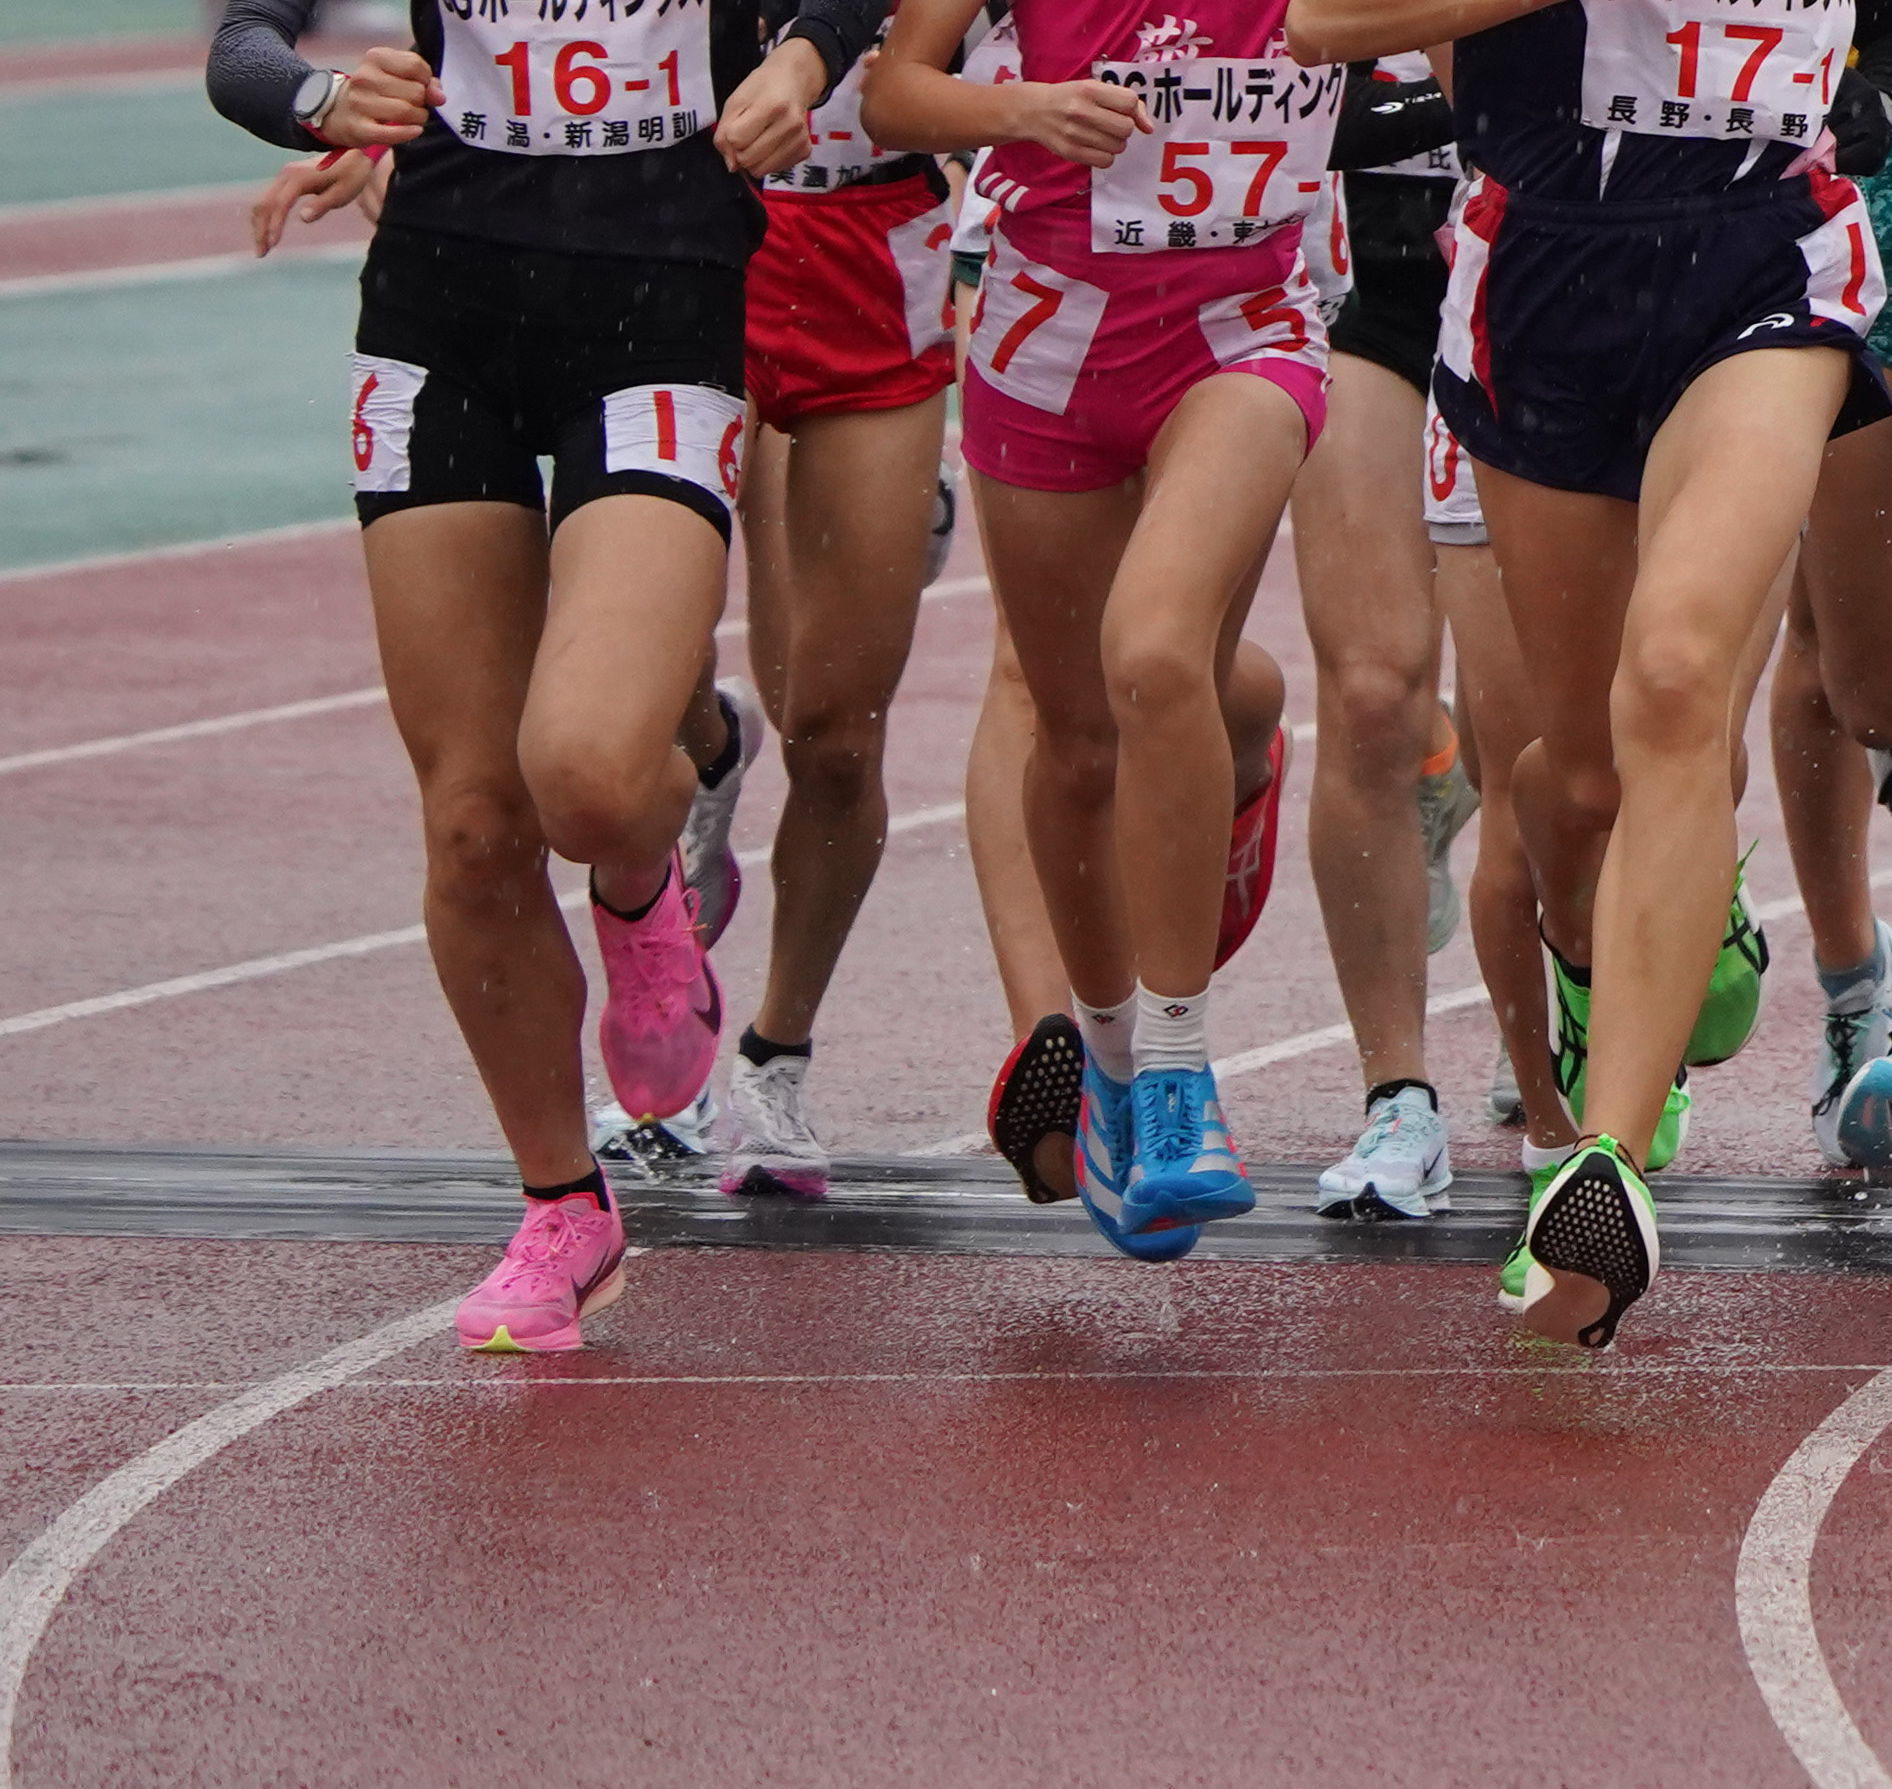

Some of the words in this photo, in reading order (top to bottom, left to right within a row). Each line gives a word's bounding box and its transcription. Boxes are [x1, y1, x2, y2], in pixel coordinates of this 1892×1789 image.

[495, 41, 681, 116] 16-1
[1666, 21, 1834, 106] 17-1
[460, 110, 699, 149] 新潟・新潟明訓
[1607, 94, 1830, 139] 長野・長野
